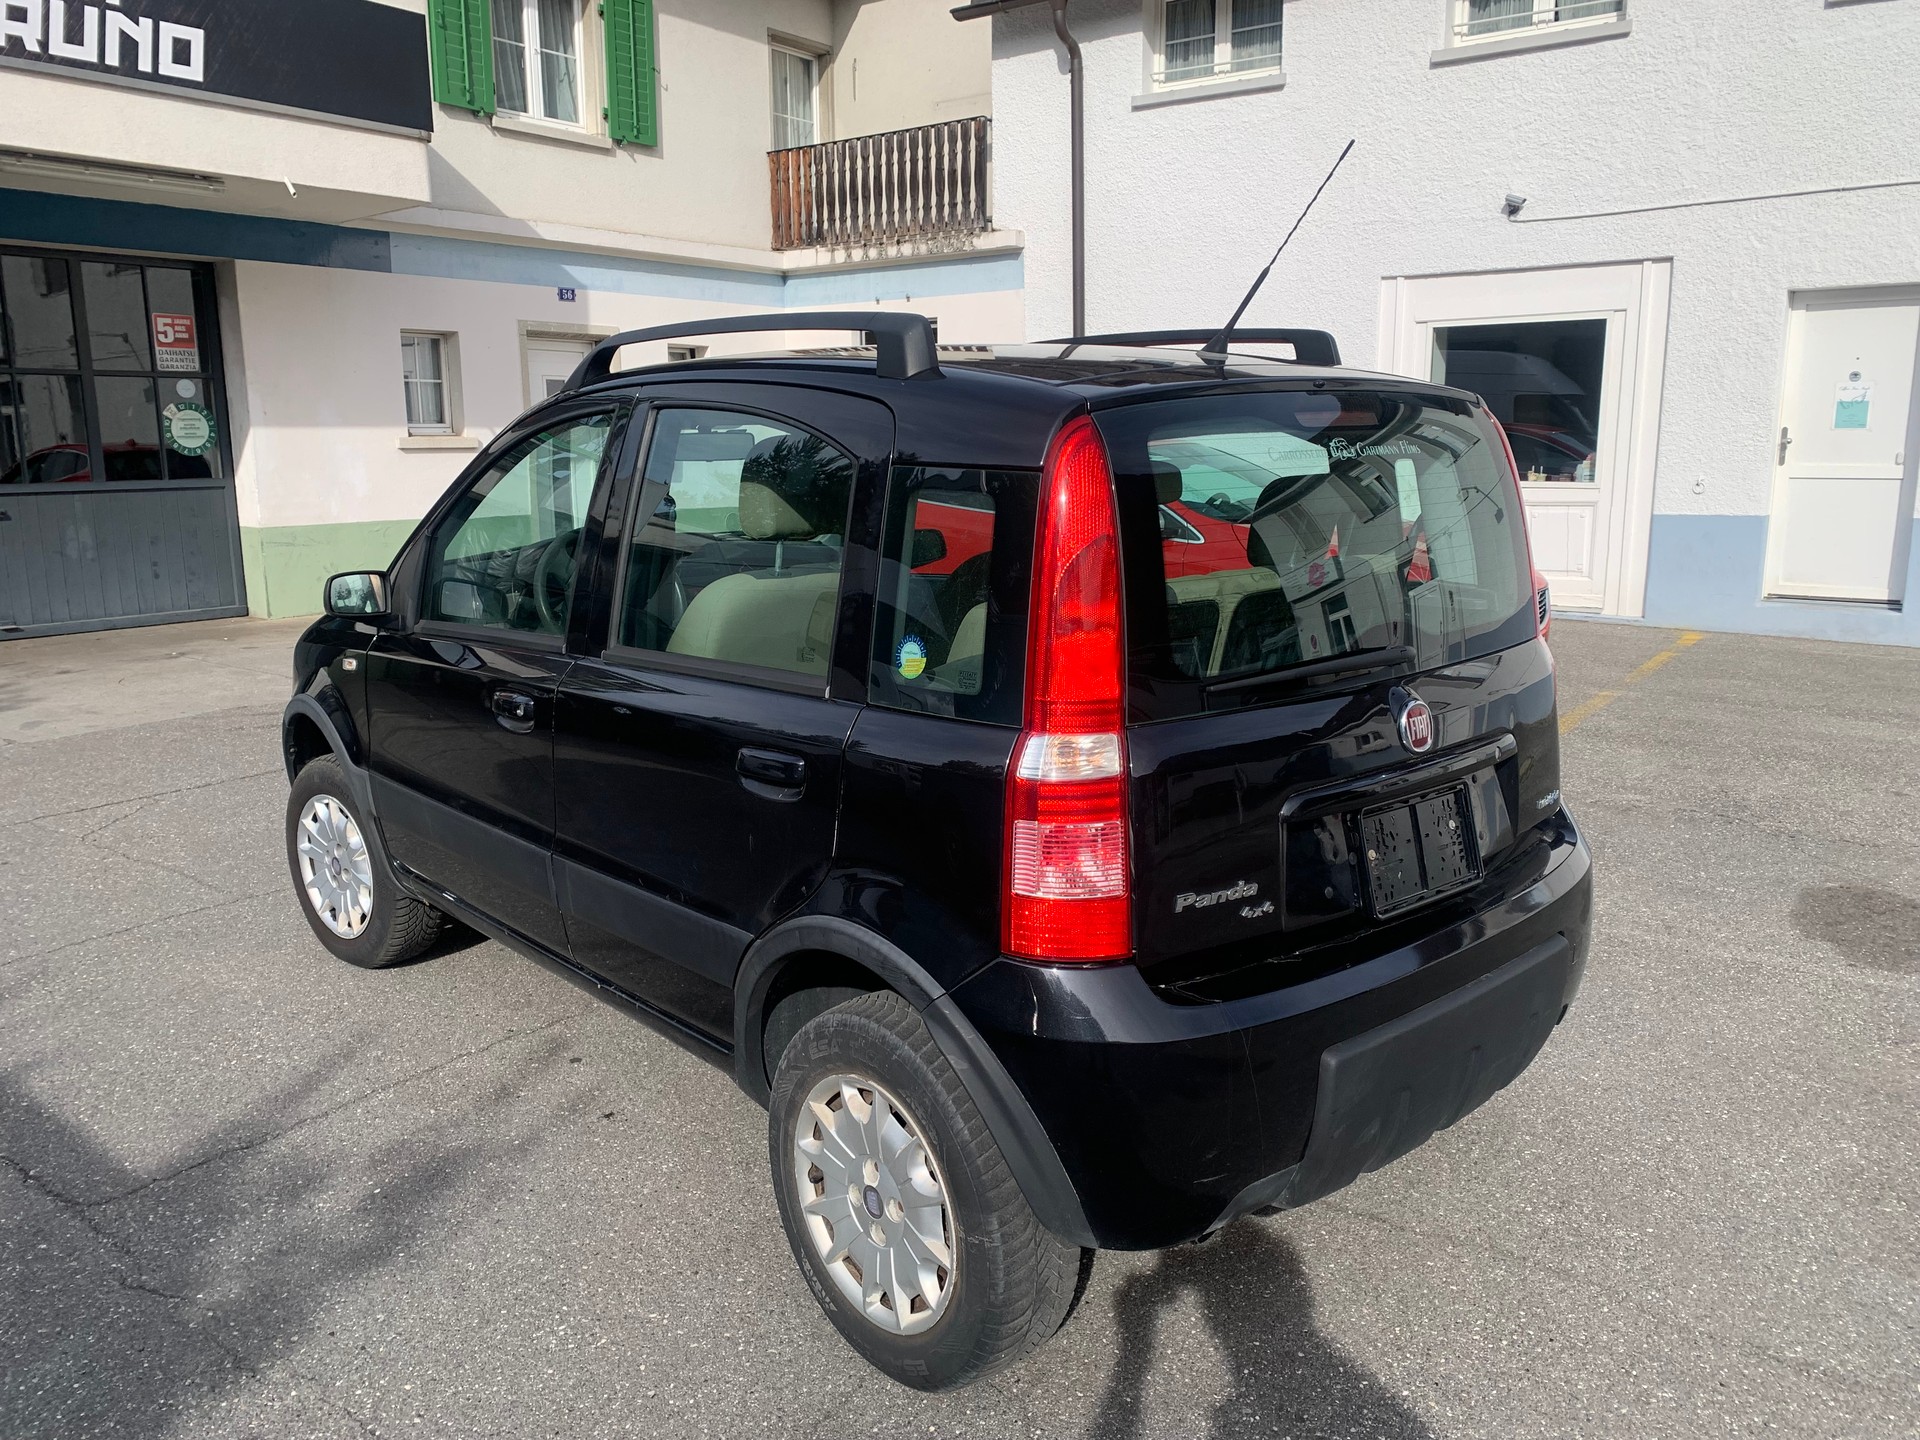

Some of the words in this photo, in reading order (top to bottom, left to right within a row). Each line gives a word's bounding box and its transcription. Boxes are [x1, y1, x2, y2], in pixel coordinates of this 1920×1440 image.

[562, 289, 573, 300] 56
[156, 317, 175, 343] 5
[158, 349, 196, 357] DAIHATSU
[159, 356, 196, 364] GARANTIE
[1408, 714, 1429, 741] FIAT
[1174, 880, 1259, 914] Panda
[1240, 901, 1275, 919] 4x4
